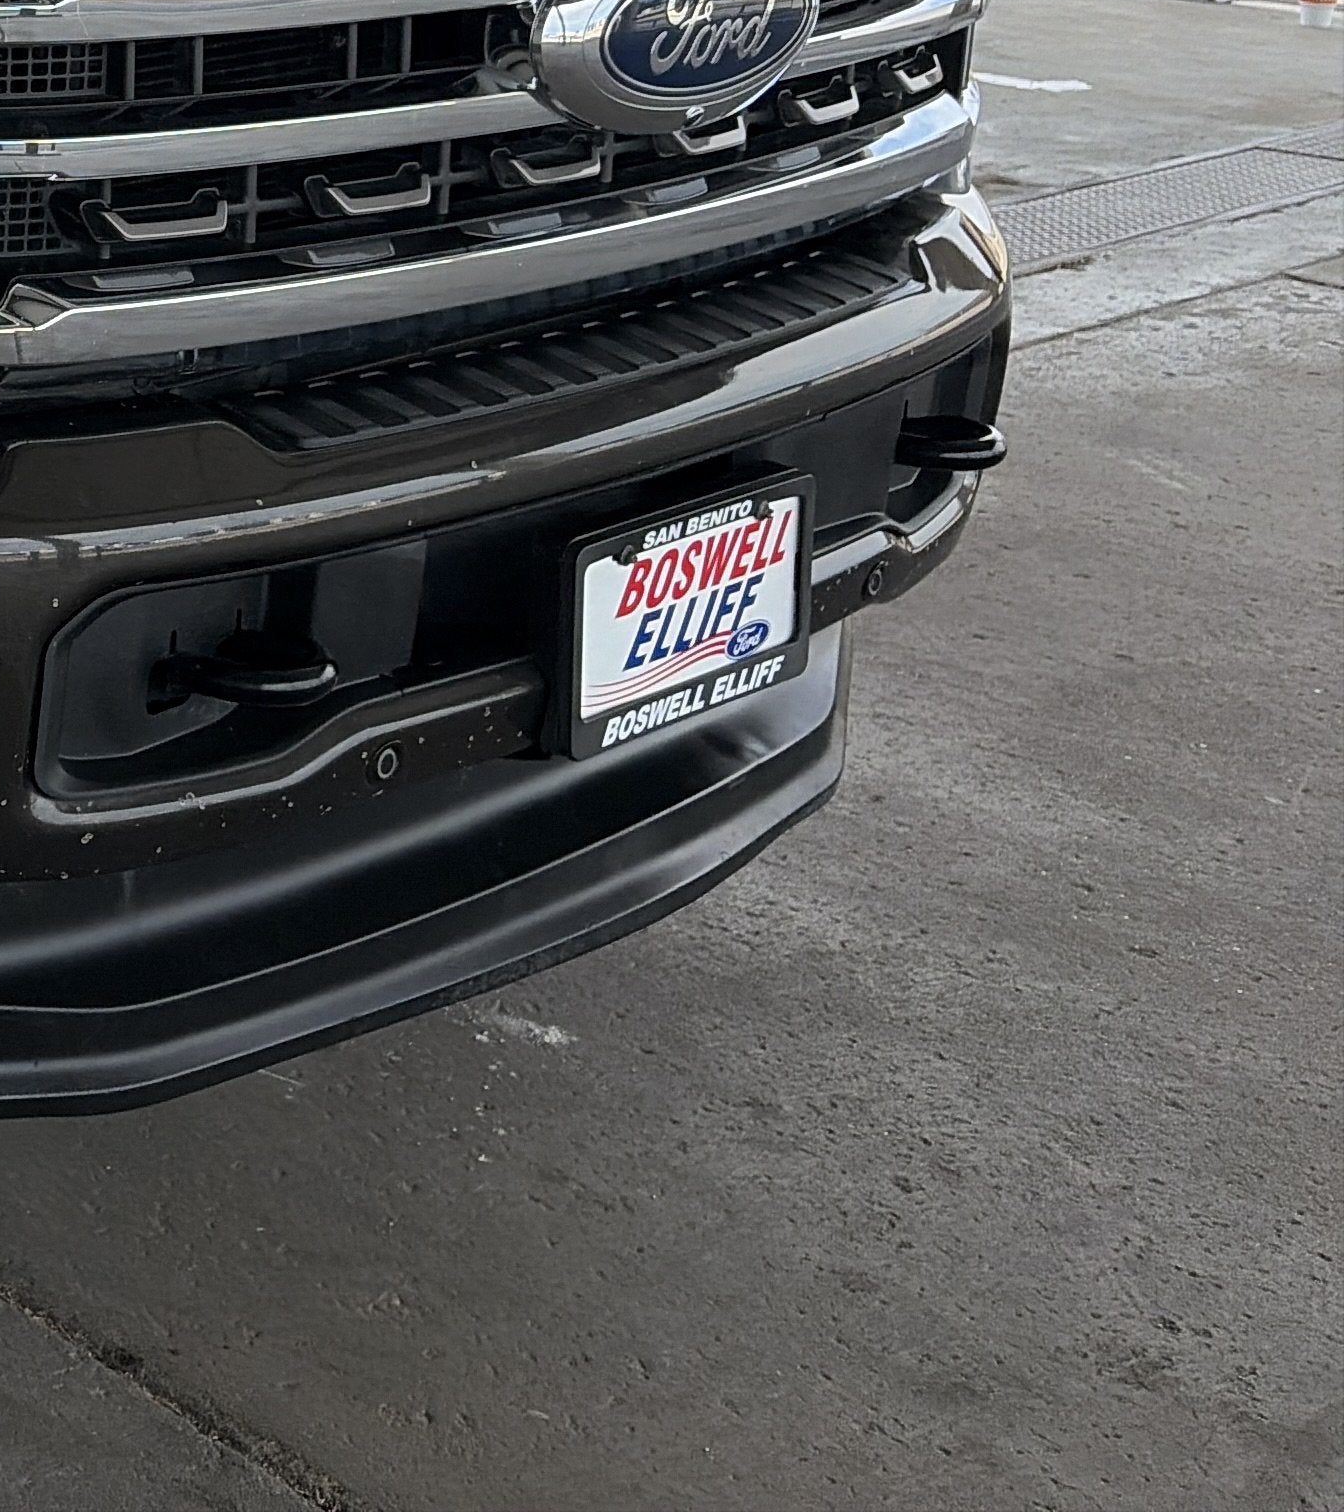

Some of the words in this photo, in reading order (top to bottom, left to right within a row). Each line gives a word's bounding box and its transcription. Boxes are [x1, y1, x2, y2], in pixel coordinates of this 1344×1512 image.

[615, 509, 793, 619] BOSWELL
[642, 522, 683, 550] SAN
[686, 499, 753, 534] BENITO
[622, 572, 765, 672] ELLIFF
[731, 627, 763, 658] Ford
[601, 683, 706, 748] BOSWELL
[710, 655, 786, 706] ELLIFF
